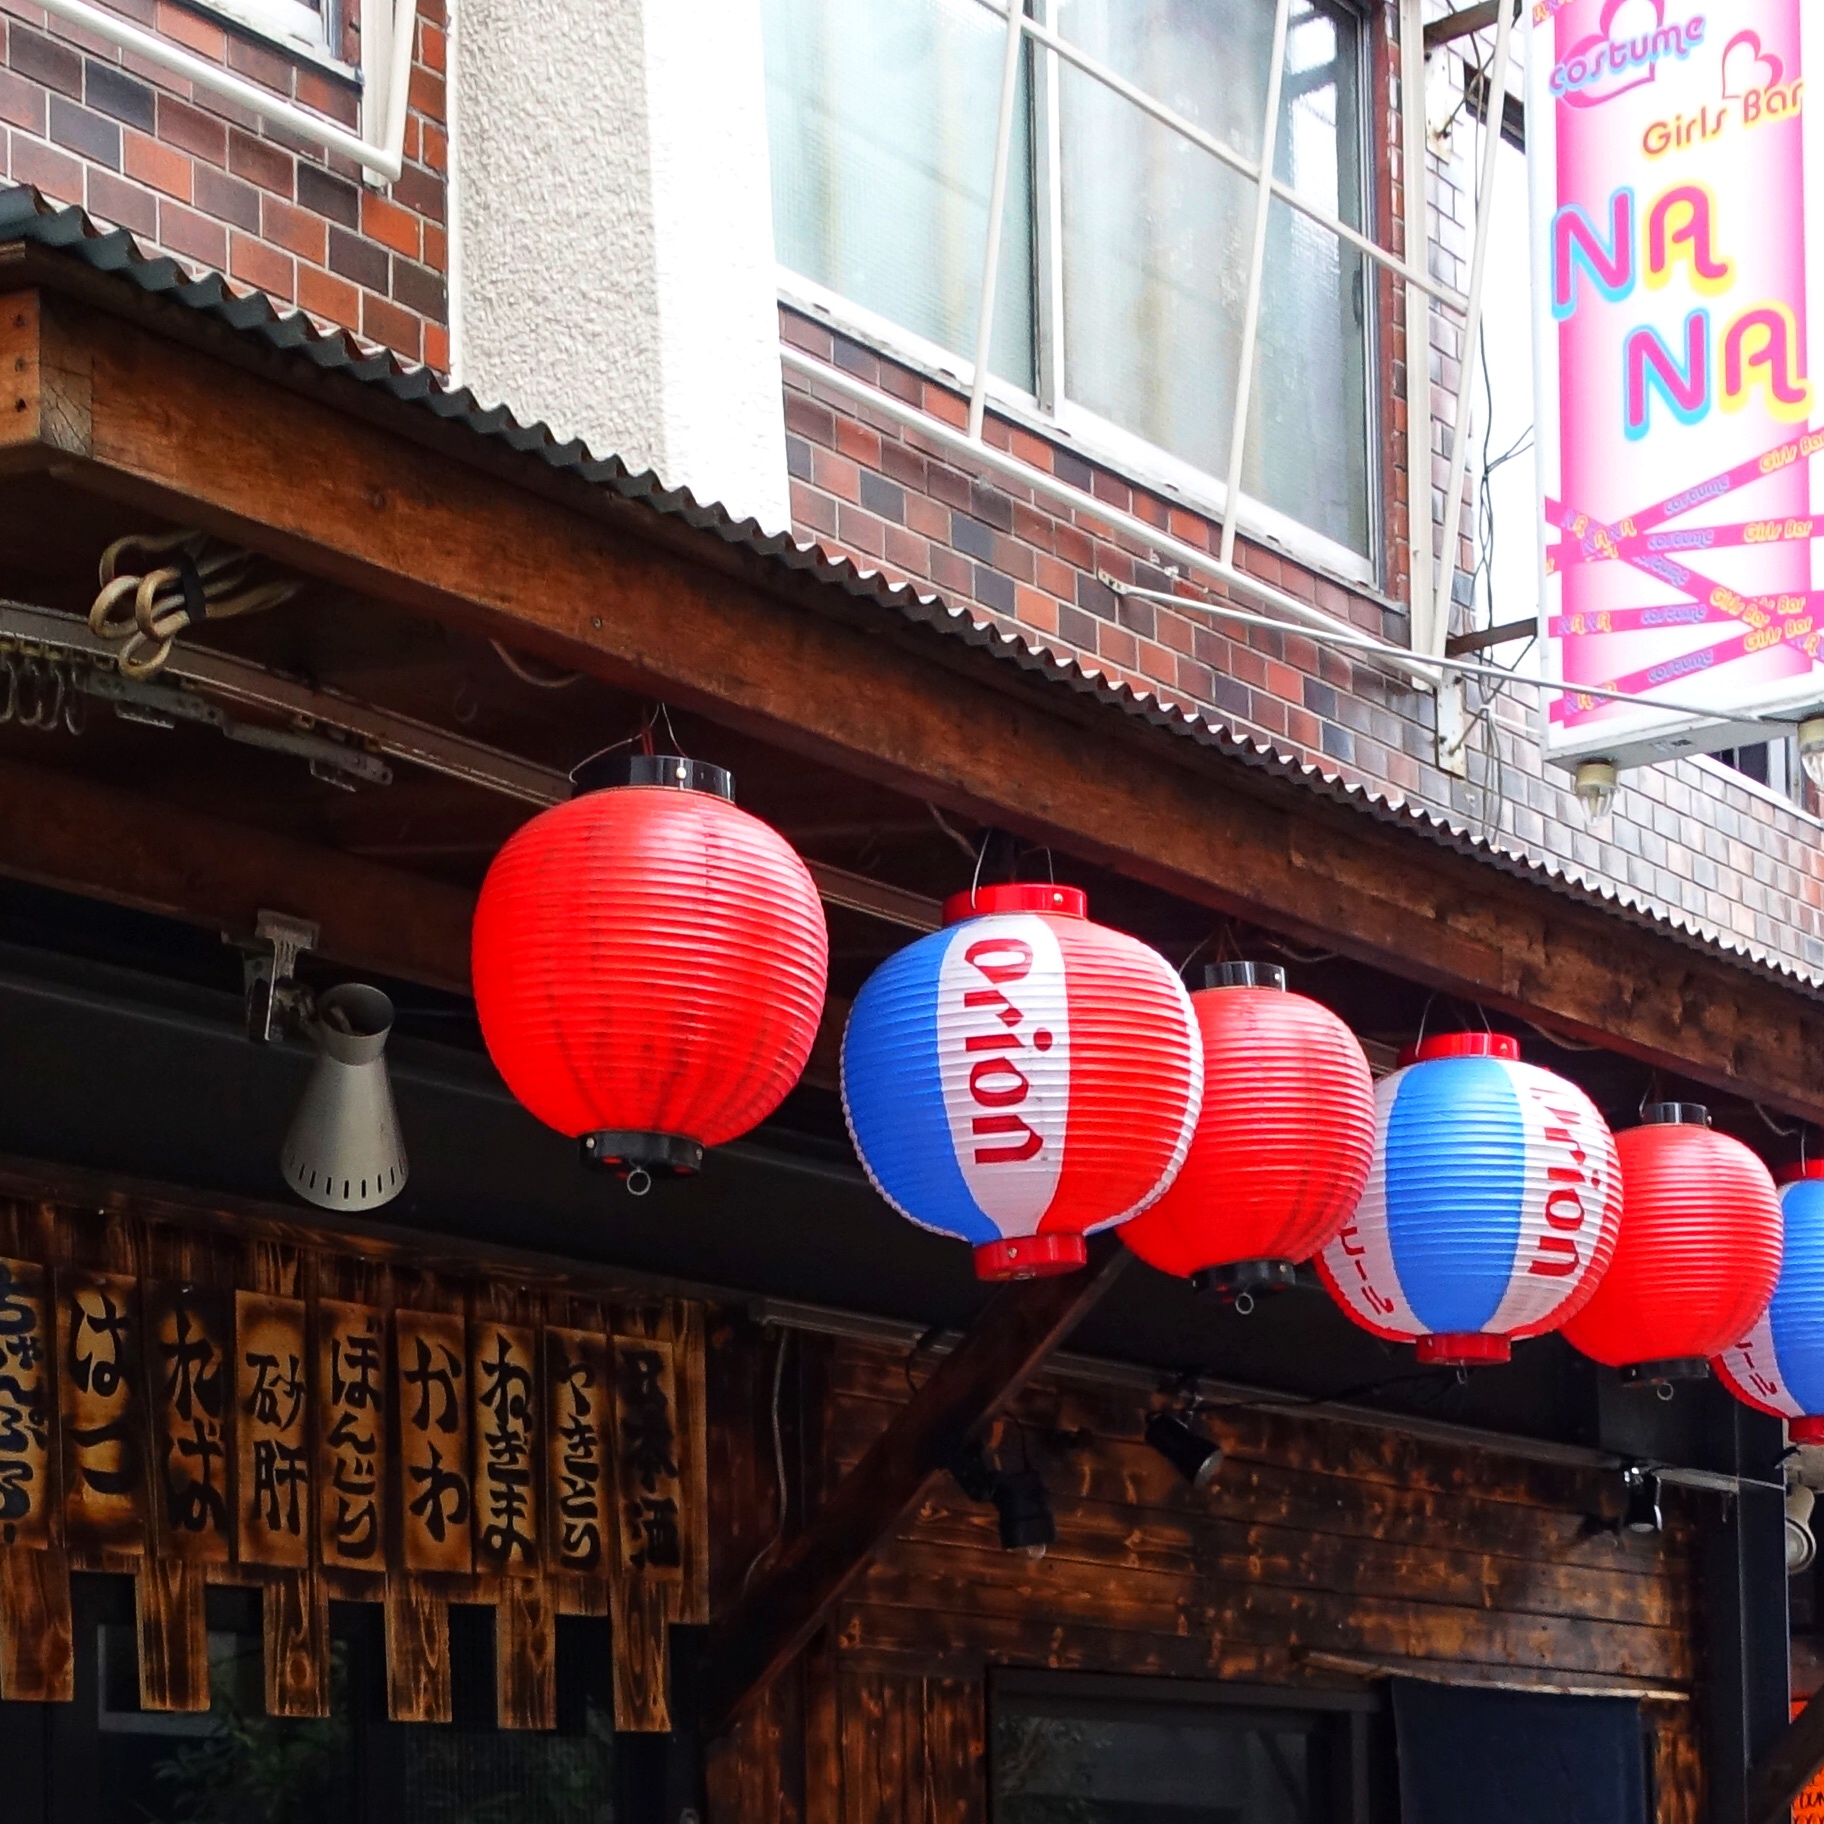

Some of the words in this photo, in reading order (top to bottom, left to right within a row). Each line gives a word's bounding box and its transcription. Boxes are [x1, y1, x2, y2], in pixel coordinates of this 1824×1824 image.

[1549, 15, 1705, 97] costume
[1643, 104, 1727, 158] Girls
[1742, 81, 1805, 125] Bar
[1552, 182, 1733, 320] NA
[1624, 300, 1812, 440] NA
[70, 1292, 133, 1495] はつ
[244, 1353, 308, 1536] 砂肝
[404, 1335, 470, 1544] かわ
[479, 1333, 535, 1563] ねぎま
[557, 1348, 601, 1572] やきとり
